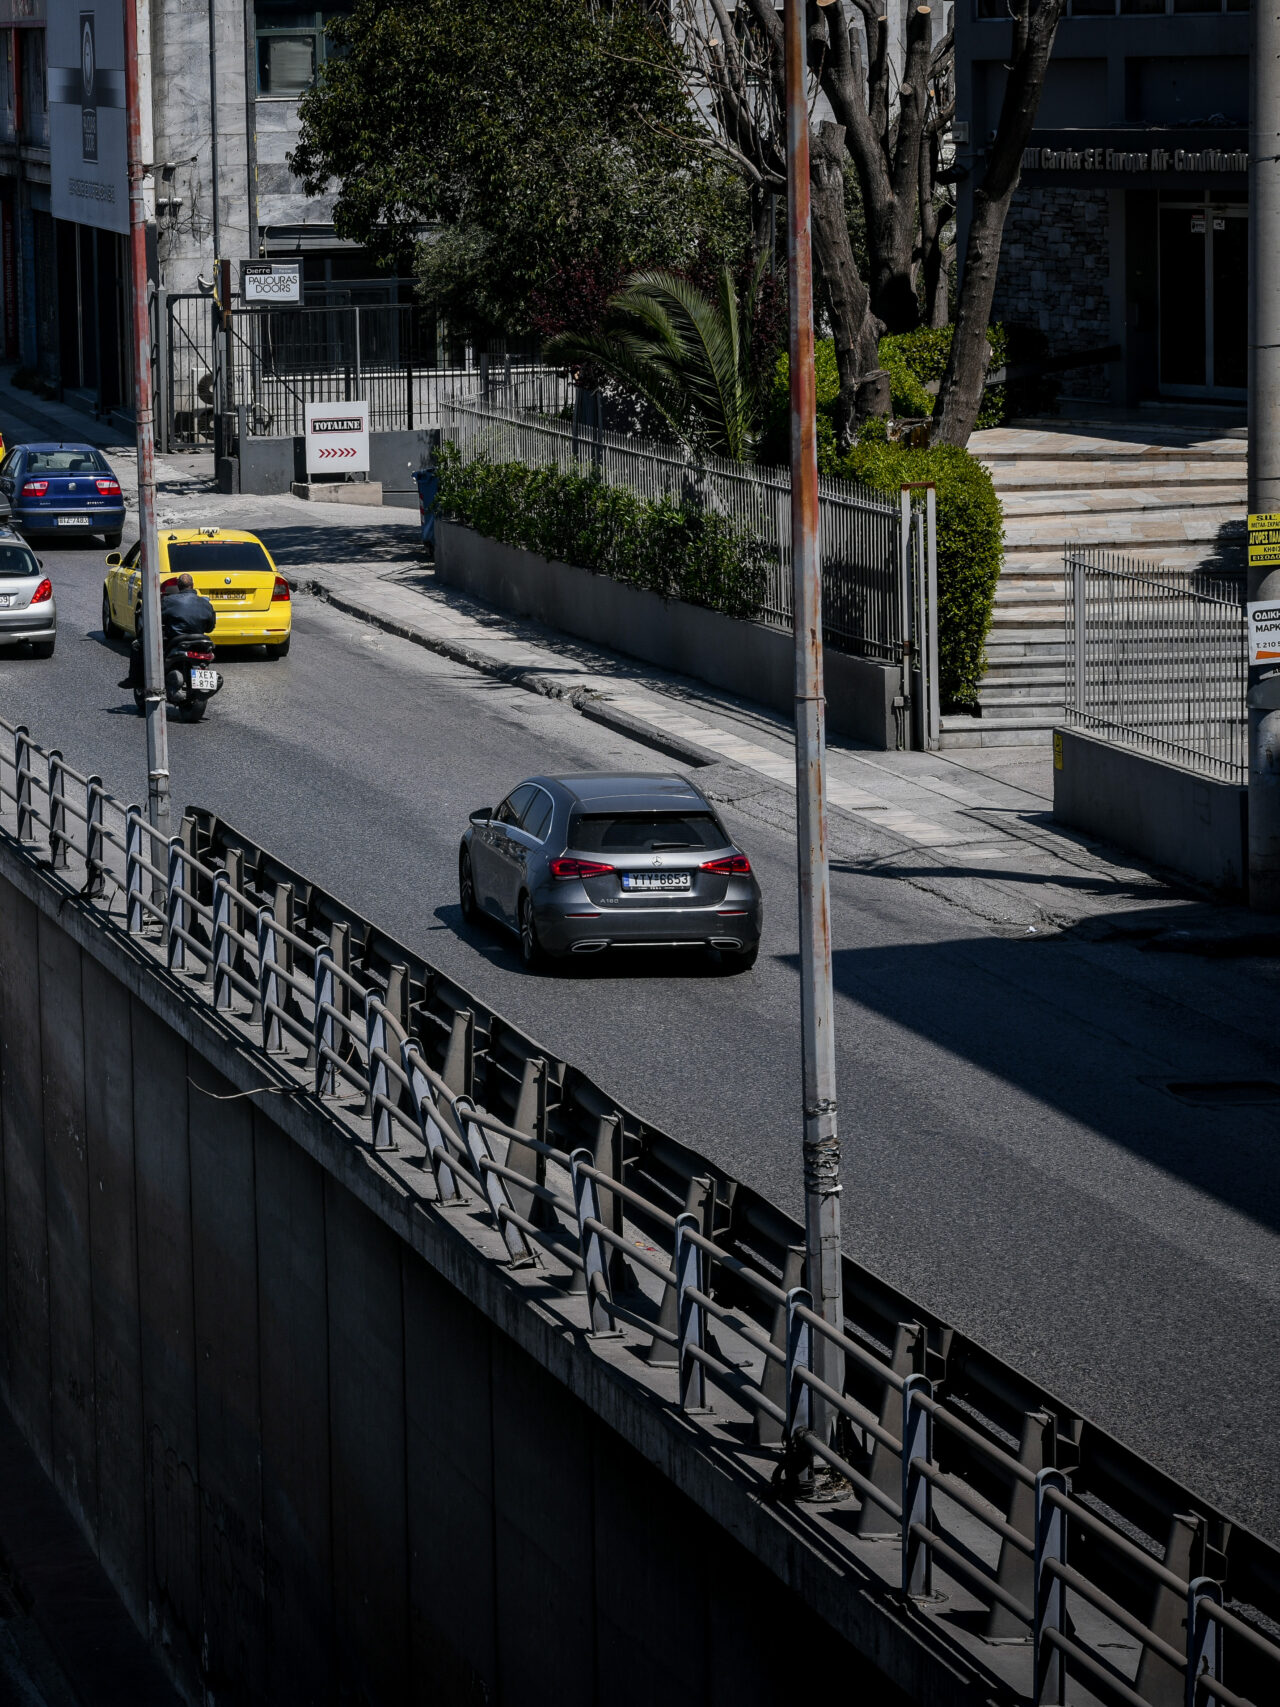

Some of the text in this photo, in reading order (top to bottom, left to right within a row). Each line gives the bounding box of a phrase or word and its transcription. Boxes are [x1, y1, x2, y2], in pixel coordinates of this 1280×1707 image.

[1041, 147, 1083, 171] Carrier
[255, 283, 291, 294] DOORS
[313, 420, 361, 431] TOTALINE
